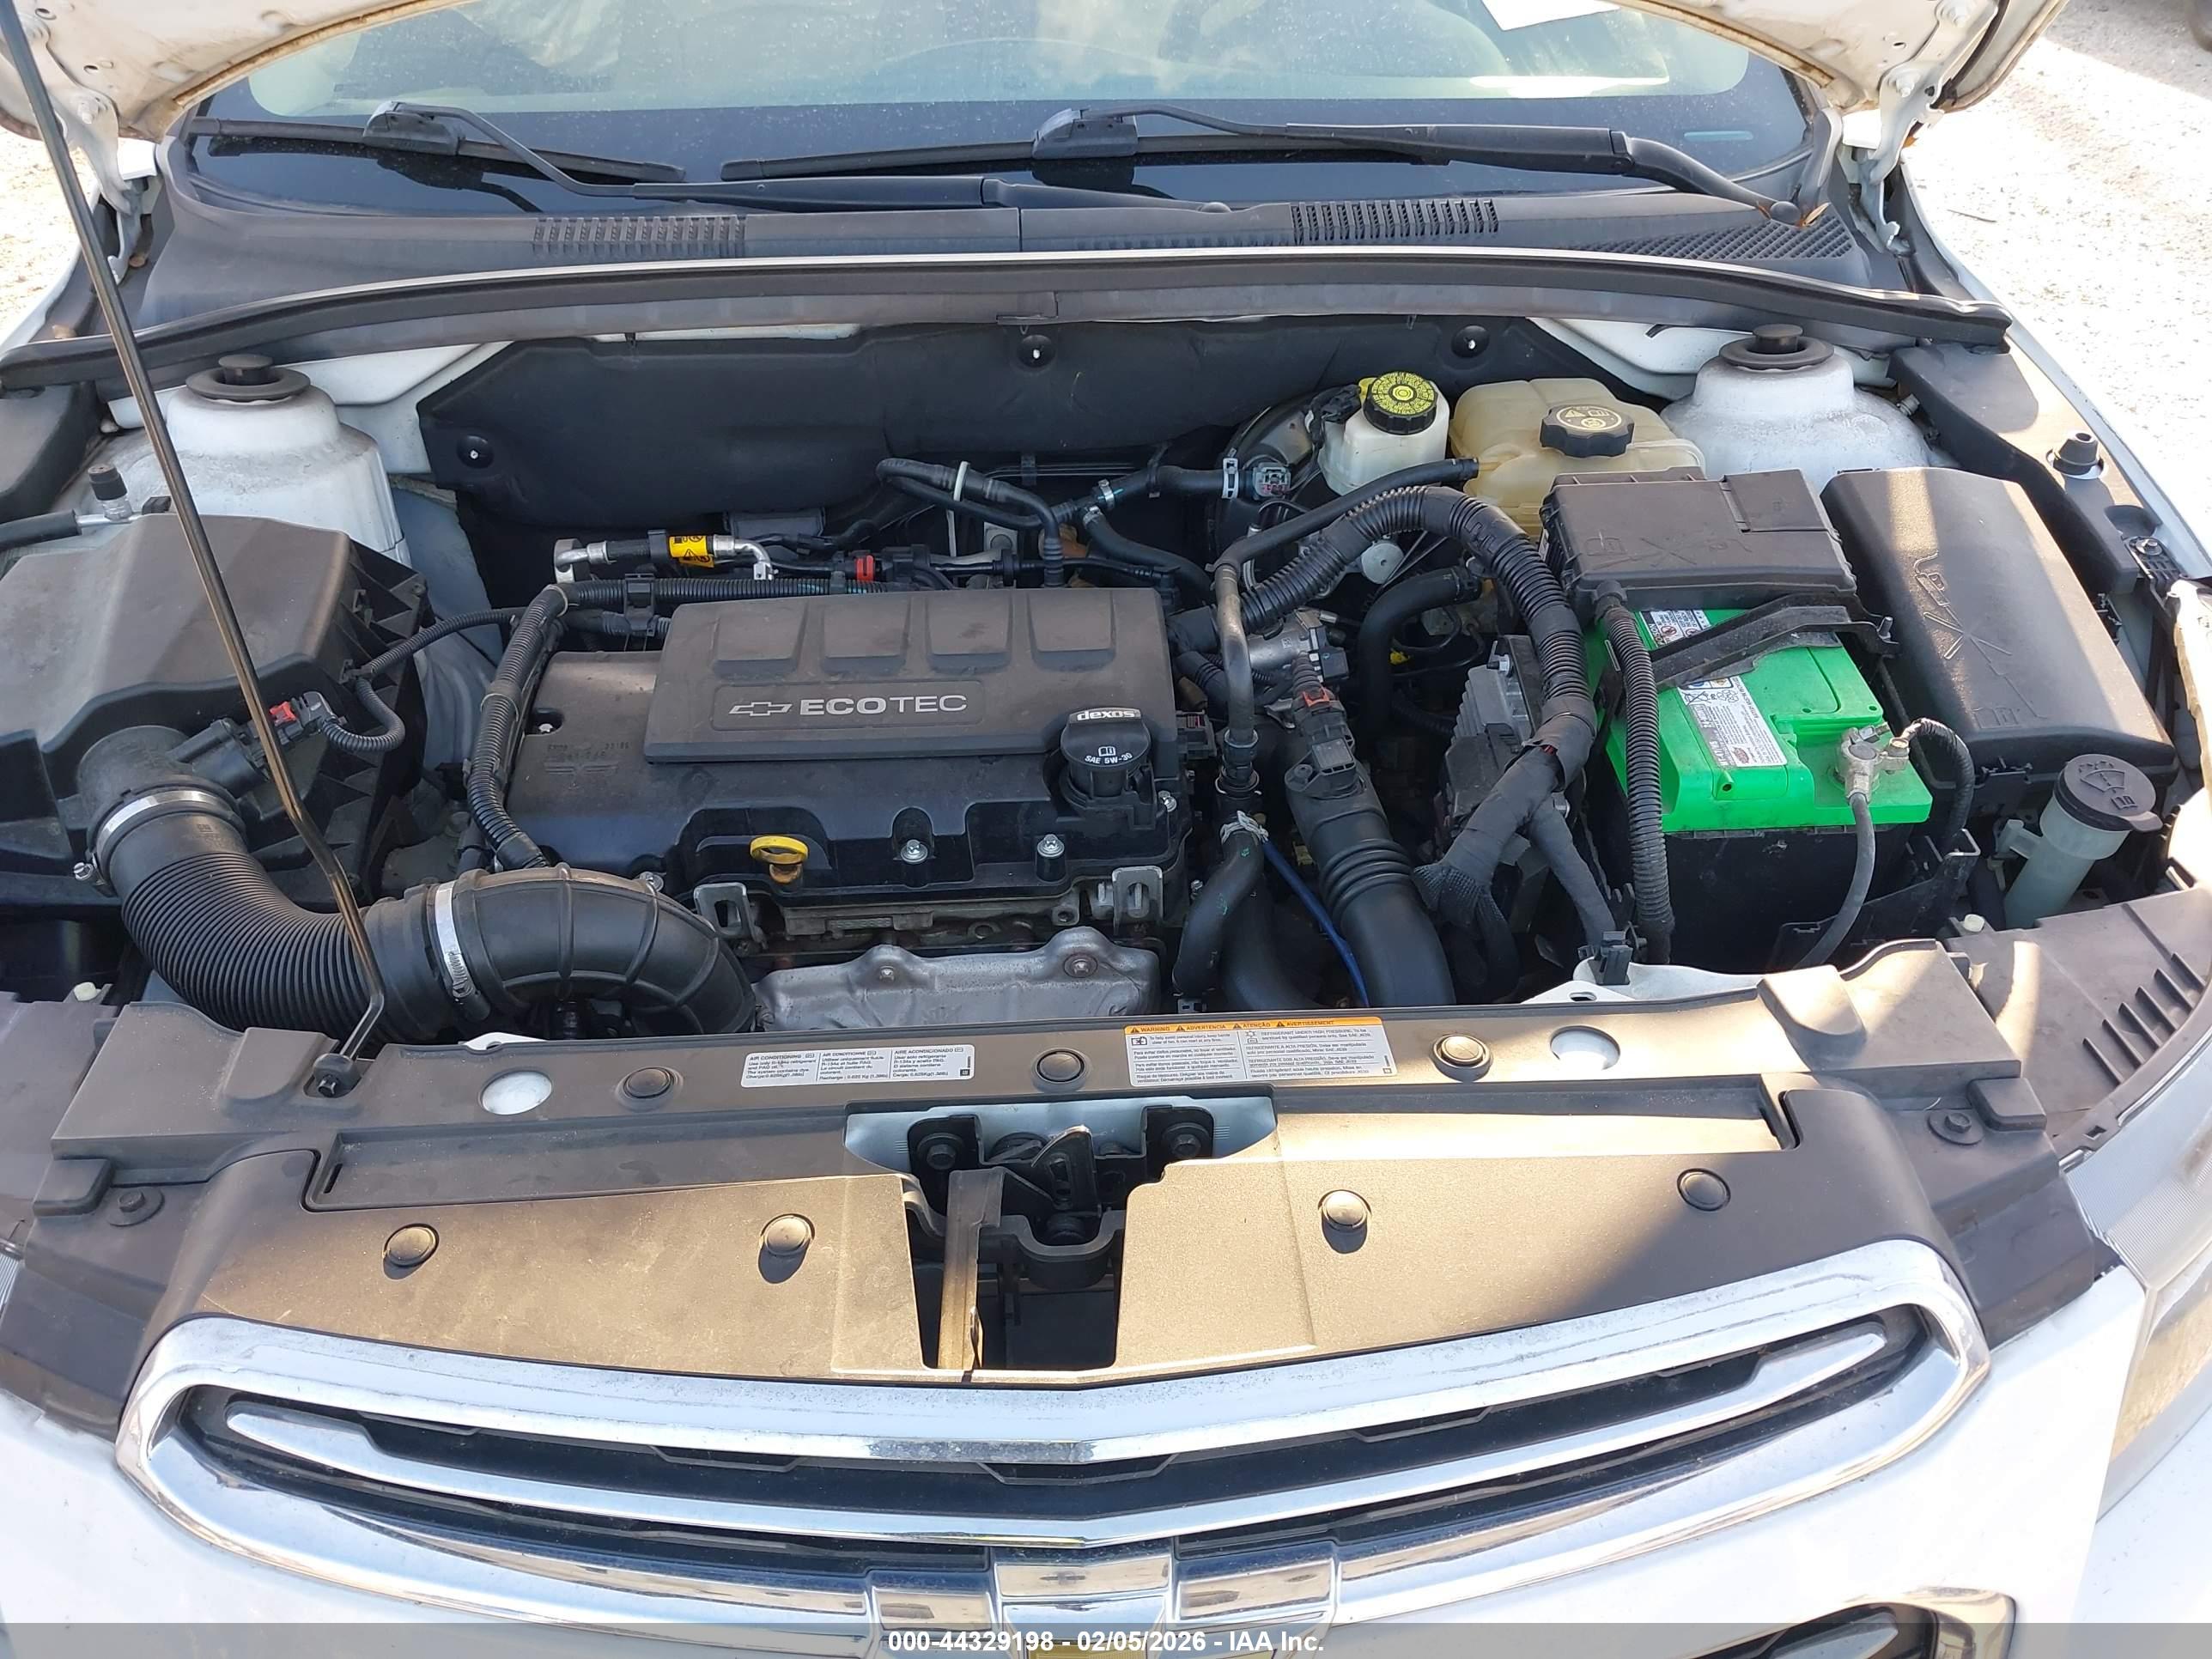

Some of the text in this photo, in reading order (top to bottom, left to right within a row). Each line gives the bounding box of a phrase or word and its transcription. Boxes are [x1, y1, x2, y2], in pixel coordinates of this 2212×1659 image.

[799, 695, 968, 715] ECOTEC
[1077, 710, 1135, 721] dexos
[1085, 752, 1133, 764] SAE 5W-30
